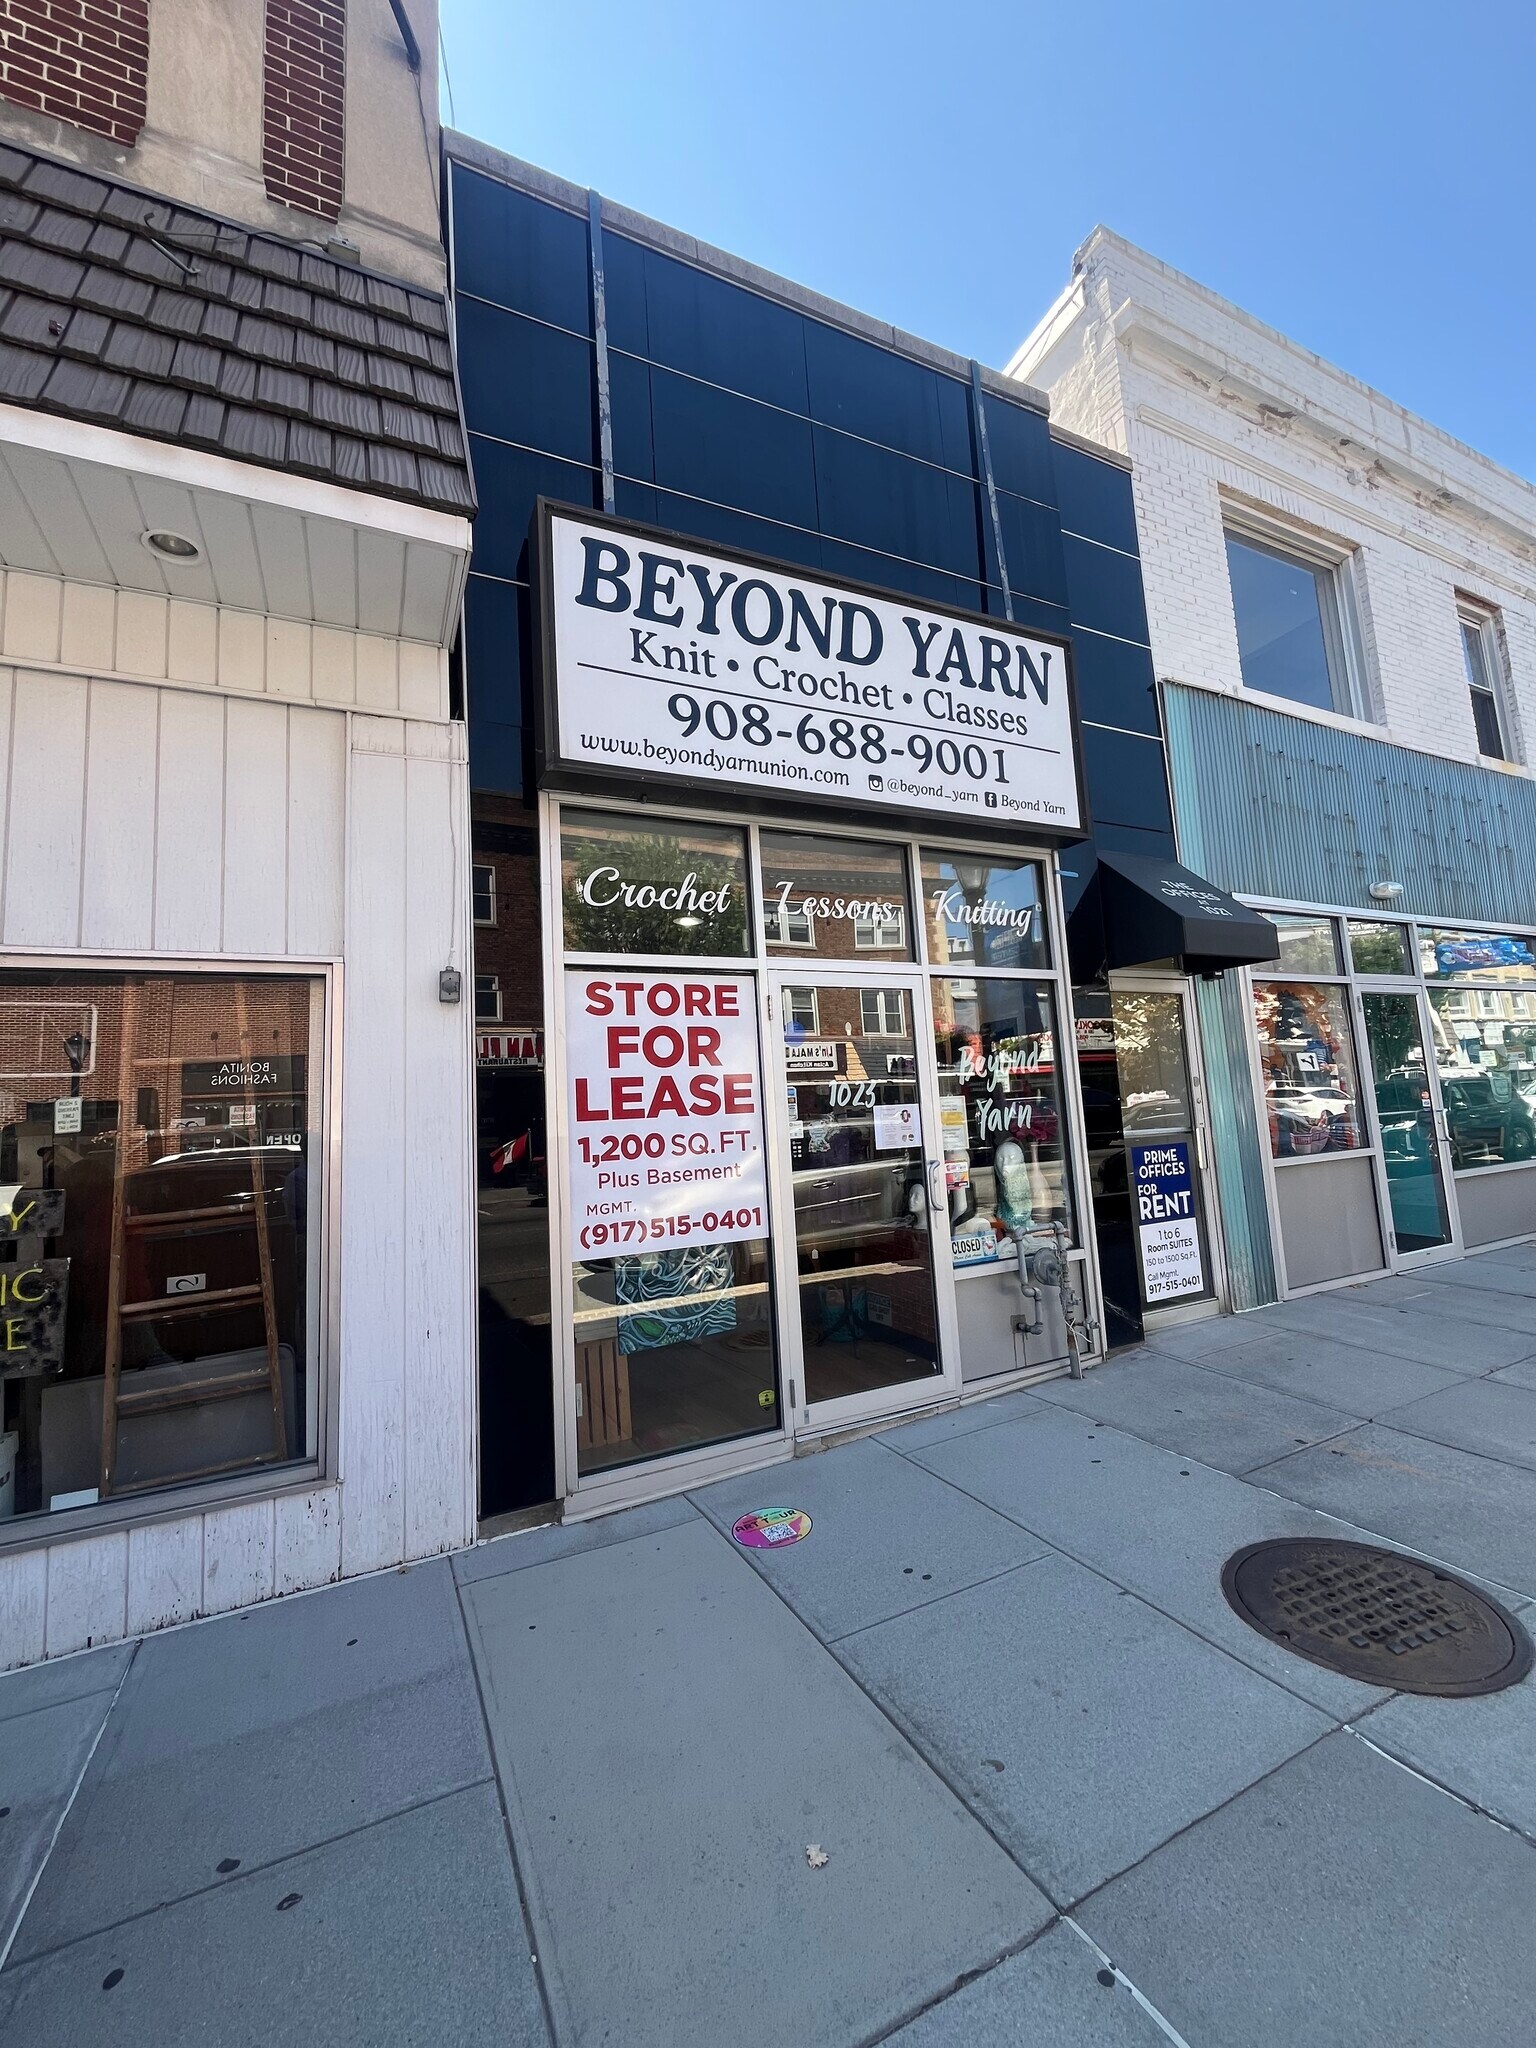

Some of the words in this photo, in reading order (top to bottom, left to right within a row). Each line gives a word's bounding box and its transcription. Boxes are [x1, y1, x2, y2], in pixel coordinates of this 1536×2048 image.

[574, 536, 884, 666] BEYOND
[902, 616, 1052, 705] YARN
[630, 627, 716, 678] Knit
[752, 655, 894, 710] Crochet
[923, 688, 1027, 736] Classes
[667, 692, 1011, 784] 908-688-9001
[580, 731, 850, 787] www.beyondyarnunion.com
[886, 778, 979, 803] @beyond_yarn
[1000, 794, 1040, 815] Beyond
[1042, 800, 1066, 816] Yarn
[583, 866, 731, 913] Crochet
[1160, 880, 1195, 890] THE
[1161, 888, 1221, 901] OFFICES
[775, 880, 897, 922] Lessons
[932, 890, 1032, 937] Knitting
[1198, 905, 1233, 916] 1021
[585, 981, 740, 1017] STORE
[606, 1025, 722, 1069] FOR
[958, 1041, 1040, 1093] Beyond
[575, 1074, 755, 1122] LEASE
[828, 1080, 877, 1109] 1023
[976, 1098, 1032, 1141] Yarn
[577, 1132, 666, 1168] 1,200
[1143, 1148, 1178, 1164] PRIME
[598, 1170, 639, 1189] Plus
[647, 1162, 742, 1185] Basement
[1139, 1161, 1186, 1179] OFFICES
[1137, 1183, 1158, 1196] FOR
[586, 1200, 637, 1216] MGMT.
[1138, 1190, 1191, 1220] RENT
[579, 1207, 762, 1250] (917)515-0401
[1158, 1229, 1163, 1240] 1
[1163, 1229, 1172, 1240] to
[1174, 1227, 1181, 1238] 6
[951, 1238, 981, 1255] CLOSED
[1147, 1242, 1168, 1253] Room
[1169, 1238, 1193, 1250] SUITES
[1145, 1257, 1157, 1267] 150
[1157, 1256, 1164, 1265] to
[1165, 1254, 1180, 1264] 1500
[1147, 1271, 1159, 1282] Call
[1159, 1269, 1179, 1282] Mgmt.
[1148, 1275, 1200, 1294] 917-515-0401
